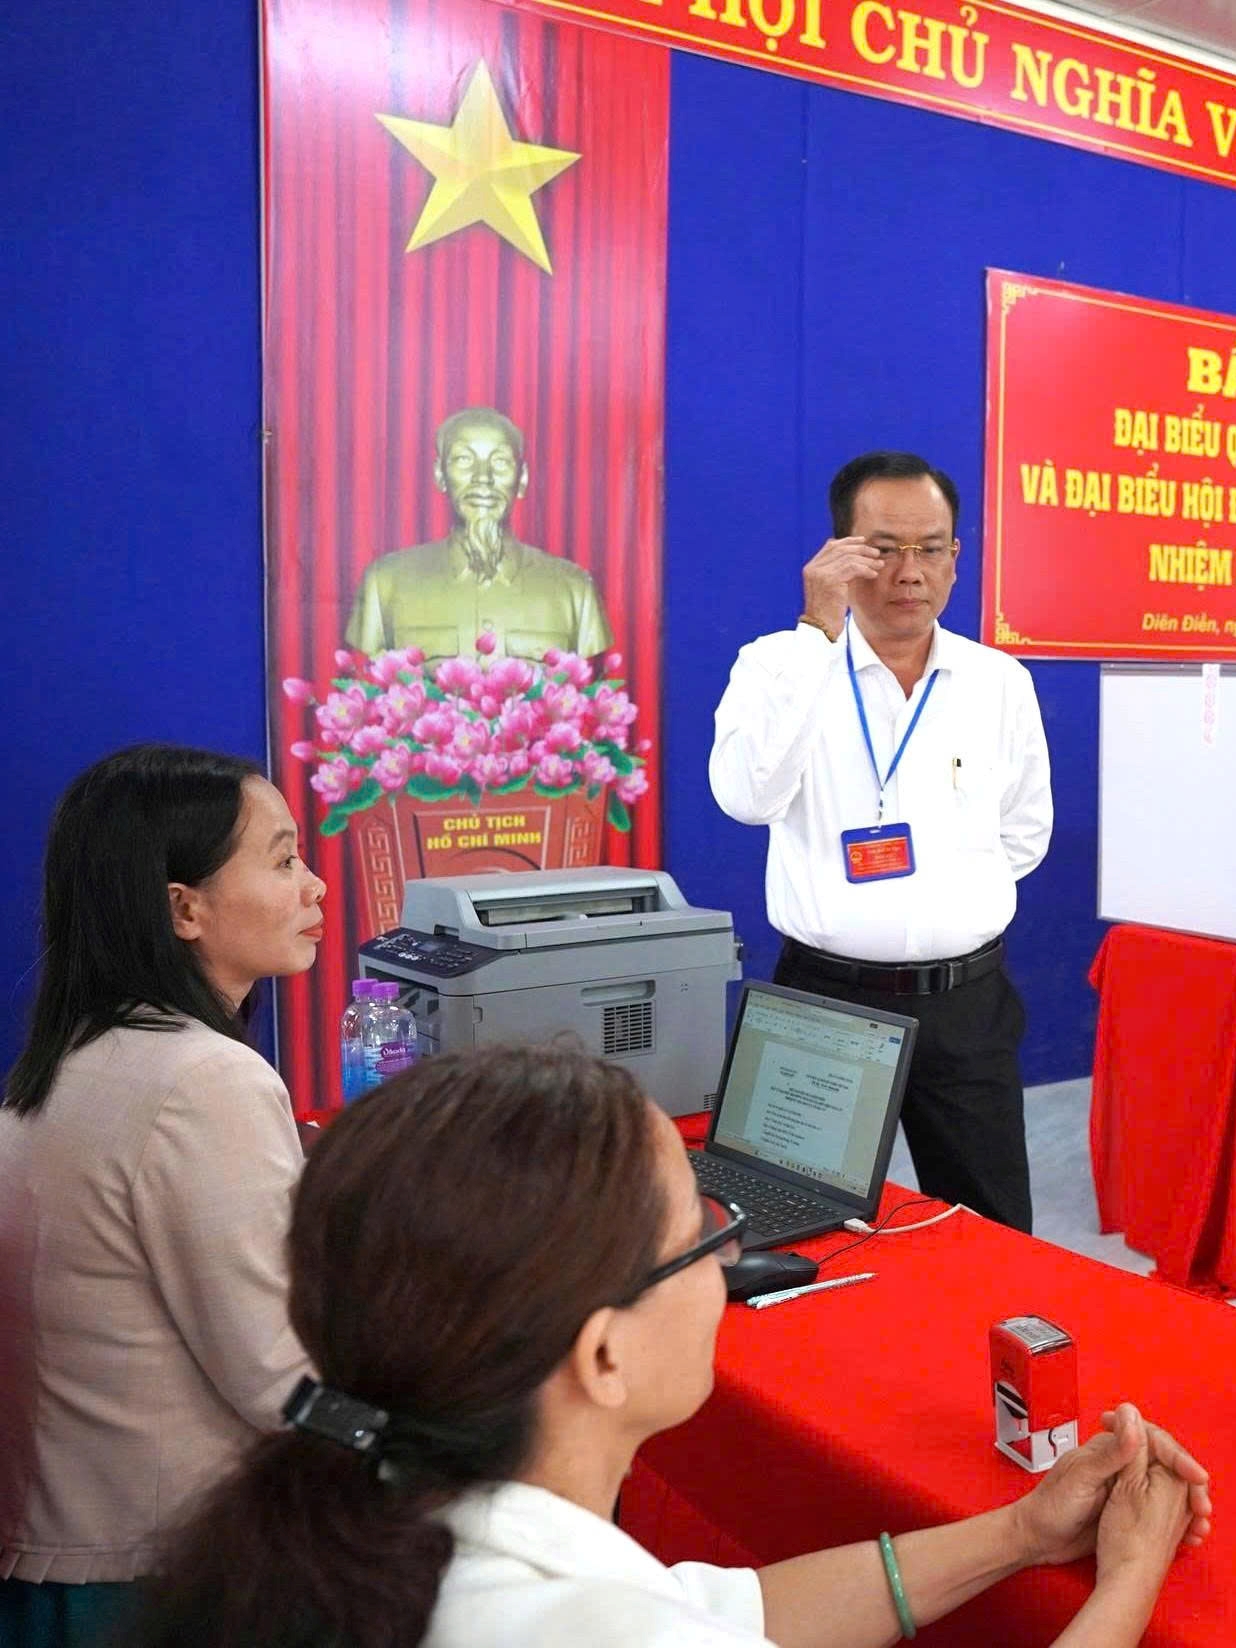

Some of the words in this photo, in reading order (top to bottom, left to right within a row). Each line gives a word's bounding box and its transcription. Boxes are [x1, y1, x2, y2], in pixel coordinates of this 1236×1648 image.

[851, 0, 990, 88] CHỦ
[1011, 43, 1194, 148] NGHĨA
[1113, 407, 1160, 457] ĐẠI
[1163, 403, 1223, 459] BIỂU
[1020, 461, 1060, 507] VÀ
[1064, 468, 1113, 518] ĐẠI
[1117, 462, 1178, 518] BIỂU
[1181, 476, 1224, 529] HỘI
[1148, 541, 1234, 592] NHIỆM
[1142, 612, 1178, 632] Diên
[426, 831, 454, 850] HỒ
[457, 832, 490, 849] CHÍ
[493, 831, 543, 847] MINH
[442, 813, 481, 831] CHỦ
[486, 814, 527, 831] TỊCH
